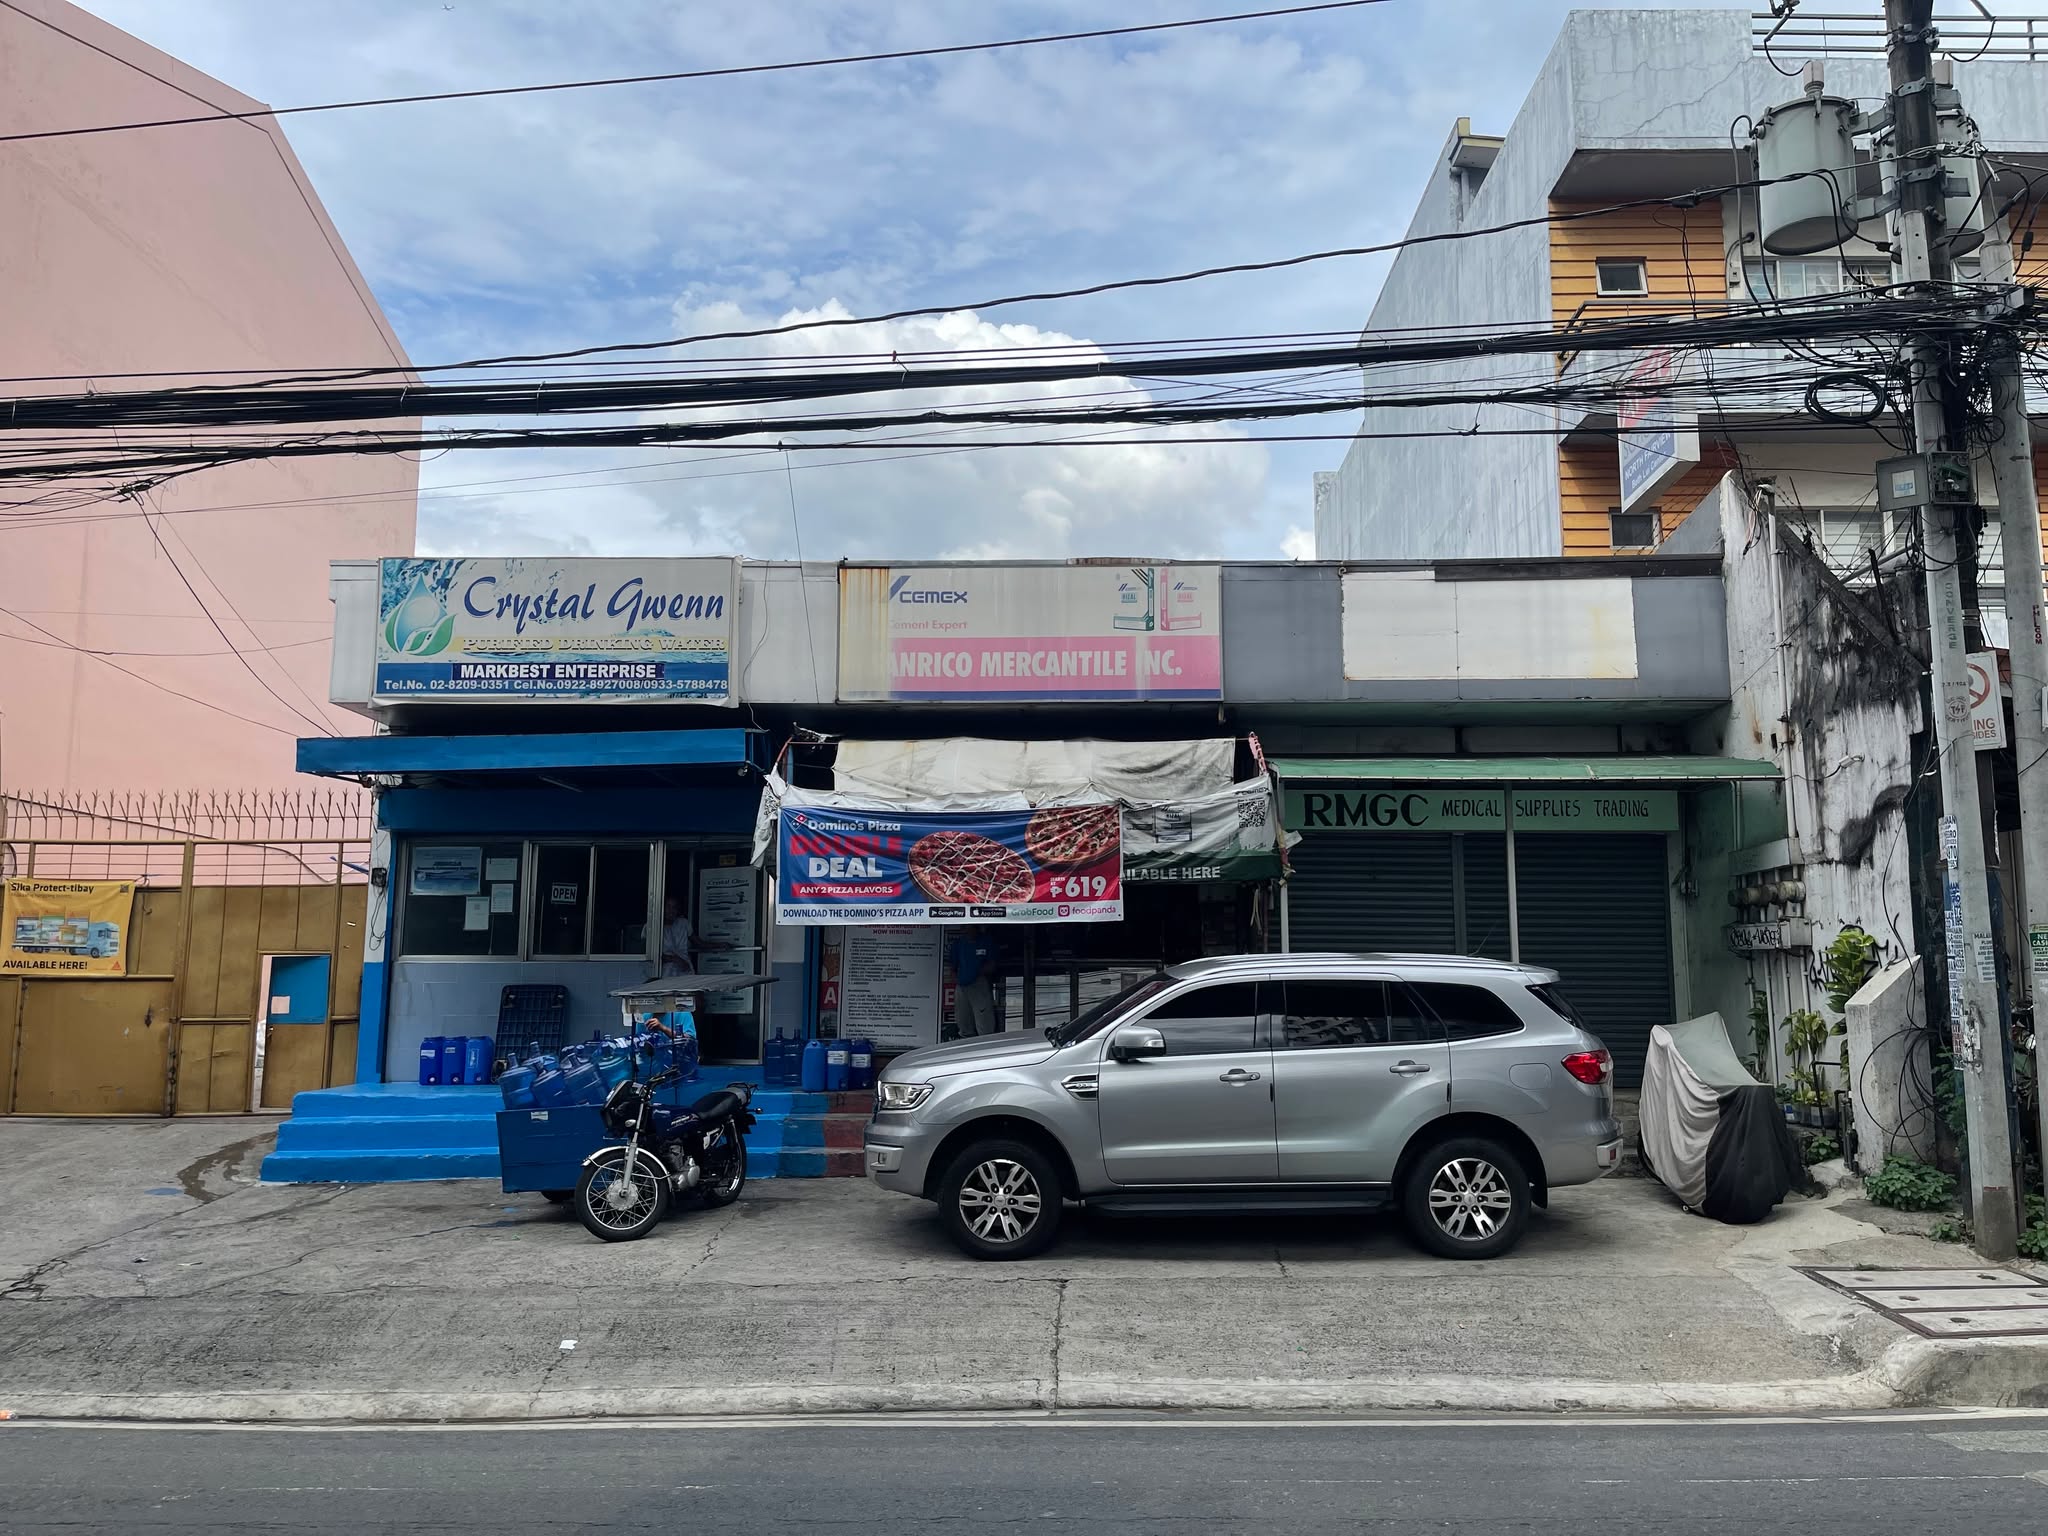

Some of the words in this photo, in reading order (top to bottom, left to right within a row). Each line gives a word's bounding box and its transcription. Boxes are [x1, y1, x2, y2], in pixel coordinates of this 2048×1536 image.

[899, 591, 968, 604] CEMEX
[464, 576, 596, 634] Crystal
[607, 577, 724, 631] Gwenn
[932, 619, 967, 632] Expert
[2032, 604, 2043, 645] PHILCOM
[463, 639, 554, 651] PURIFIED
[558, 639, 653, 651] DRINKING
[659, 639, 726, 651] WATER
[980, 649, 1127, 678] MERCANTILE
[460, 664, 551, 678] MARKBEST
[555, 664, 656, 678] ENTERPRISE
[384, 680, 427, 690] Tel.No.
[430, 679, 509, 691] 02-8209-0351
[1303, 793, 1429, 827] RMGC
[1441, 799, 1501, 817] MEDICAL
[1515, 799, 1581, 817] SUPPLIES
[1593, 799, 1650, 817] TRADING
[808, 820, 864, 831] Domino's
[868, 821, 901, 831] Pizza
[808, 857, 883, 878] DEAL
[1182, 866, 1221, 879] HERE
[11, 882, 31, 891] Sika
[33, 883, 94, 894] Protect-tibay
[553, 887, 576, 900] OPEN
[821, 886, 828, 894] 2
[828, 886, 854, 894] PIZZA
[855, 886, 893, 894] FLAVORS
[783, 908, 828, 918] DOWNLOAD
[829, 908, 843, 917] THE
[844, 908, 884, 917] DOMINO'S
[885, 908, 906, 917] PIZZA
[909, 908, 924, 917] APP
[937, 910, 953, 918] Google
[953, 910, 965, 918] Play
[1011, 907, 1054, 916] GrabFood
[1072, 906, 1116, 915] foodpanda
[3, 959, 57, 969] AVAILABLE
[58, 960, 88, 970] HERE!
